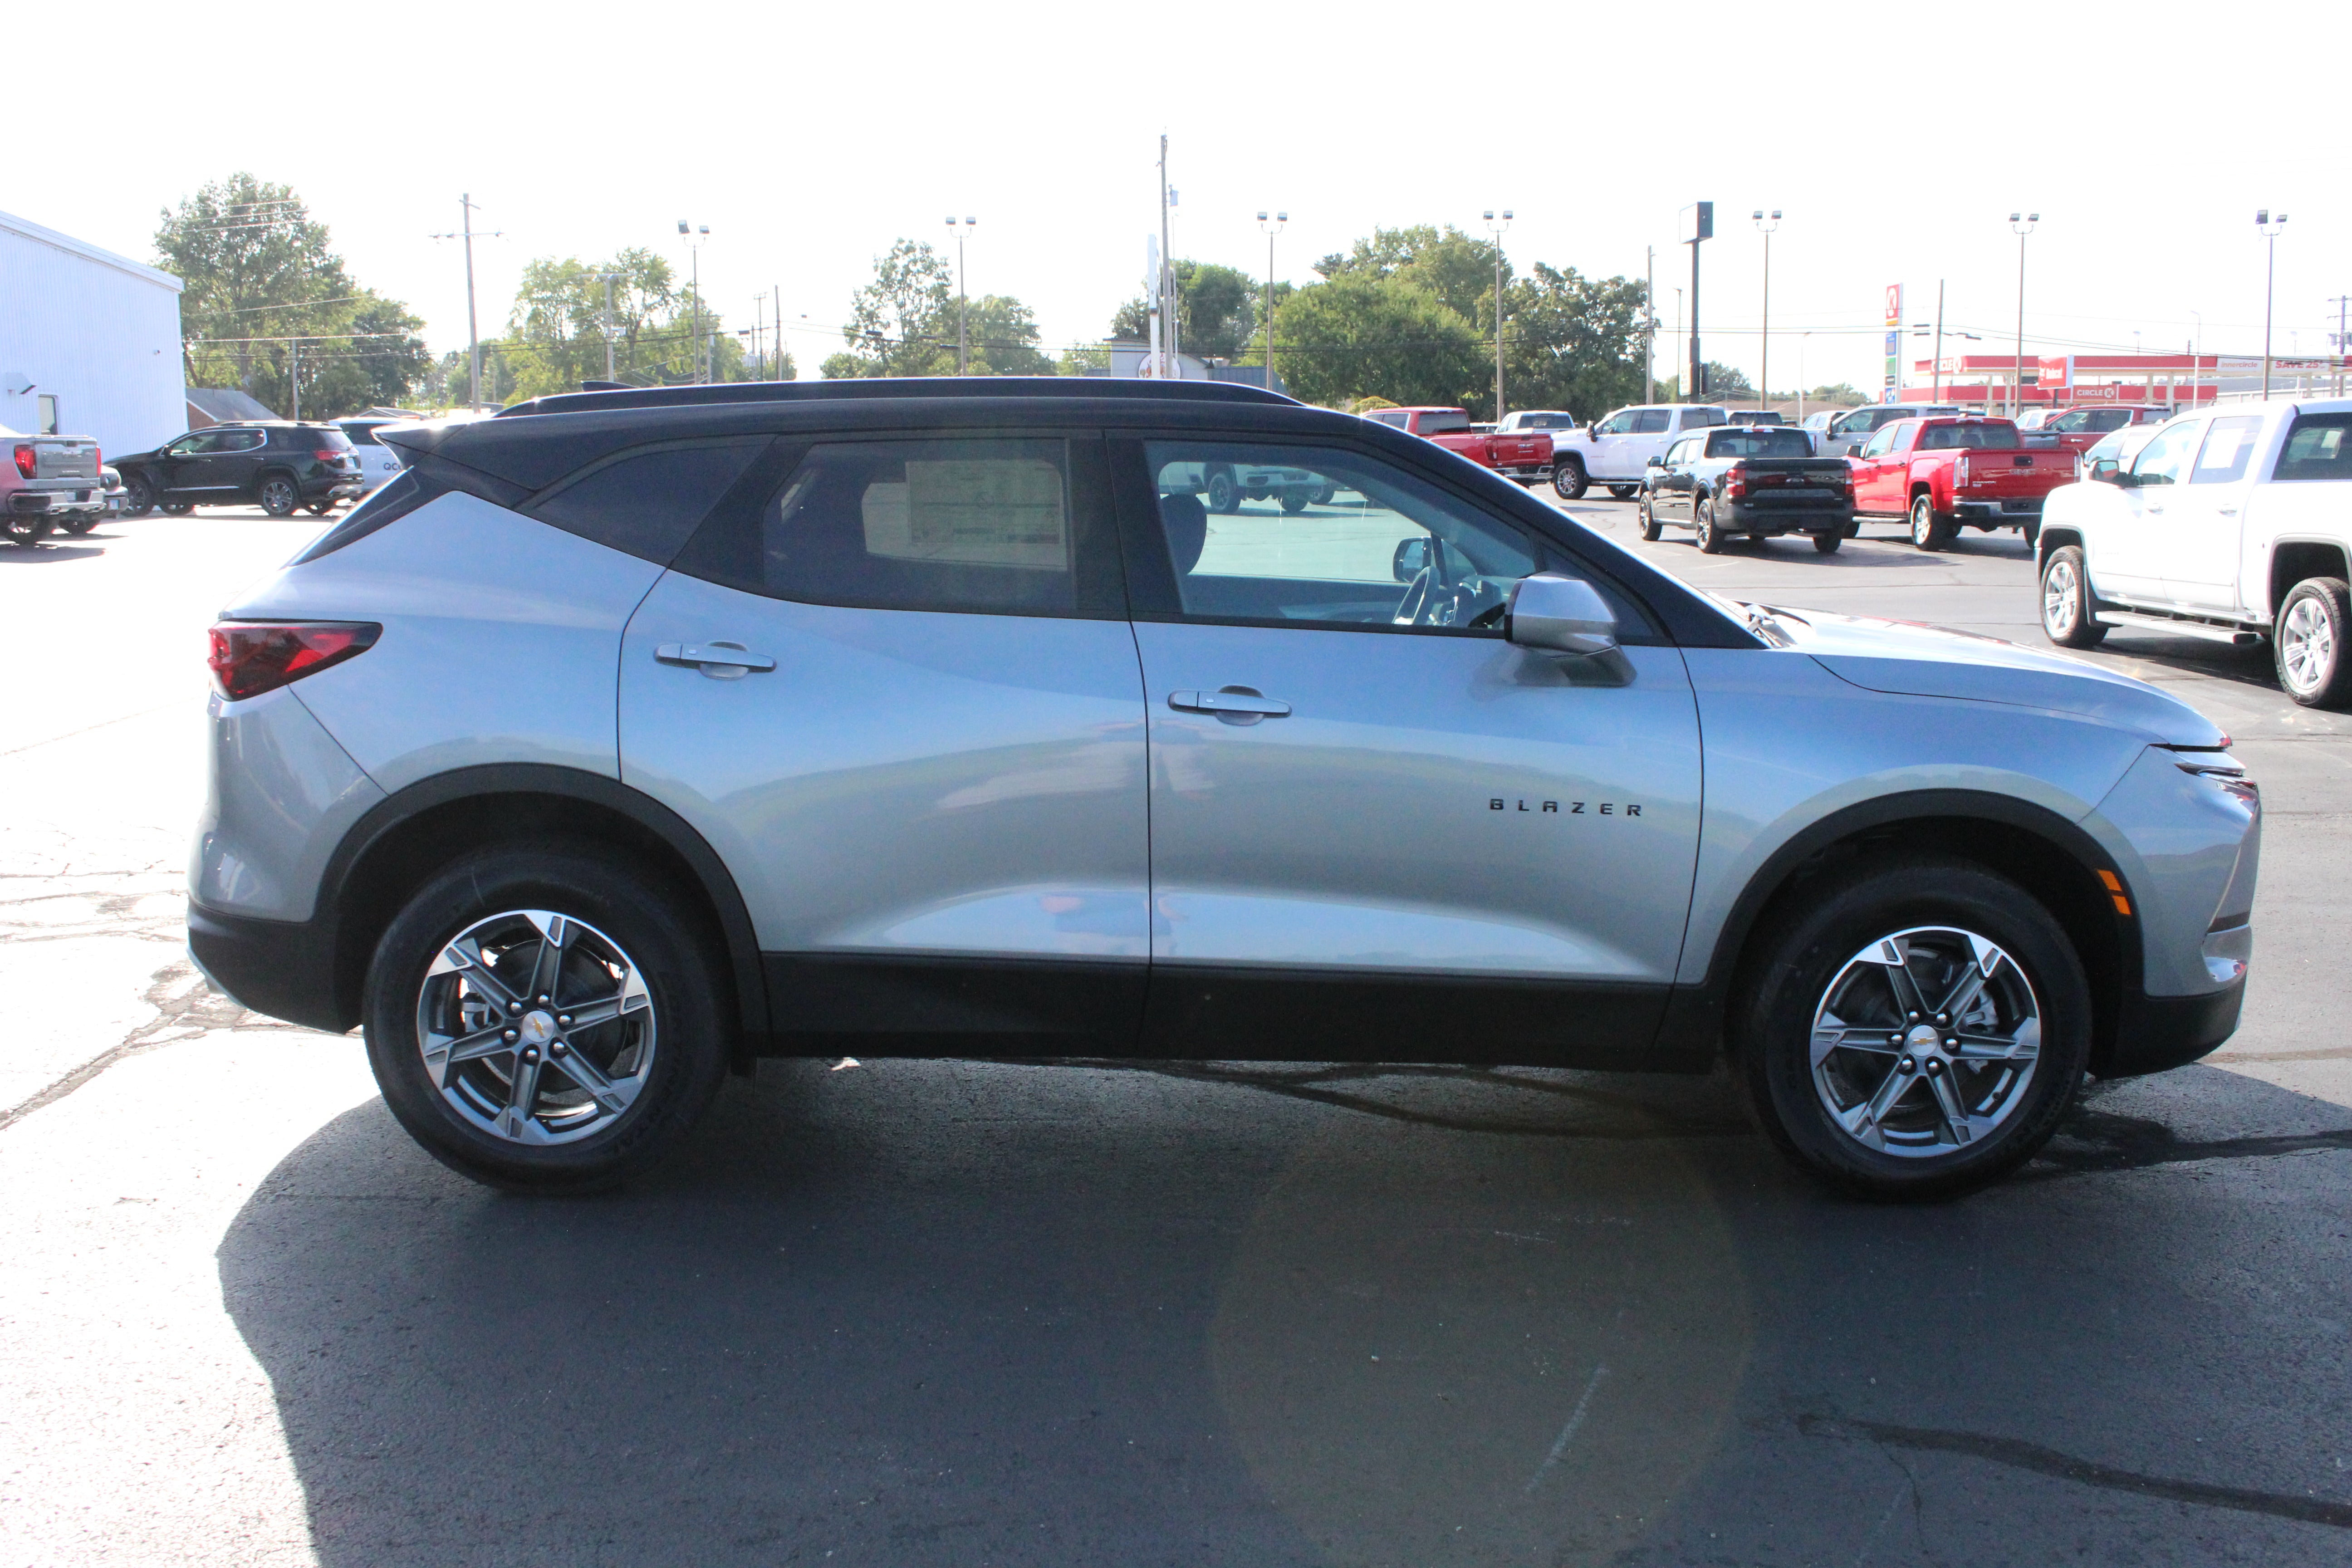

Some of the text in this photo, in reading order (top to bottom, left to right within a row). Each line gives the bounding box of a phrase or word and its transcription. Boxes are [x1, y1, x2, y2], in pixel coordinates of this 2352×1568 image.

[1931, 359, 1953, 372] CCLE
[2275, 360, 2304, 368] SAVE
[1490, 799, 1642, 816] BLAZER
